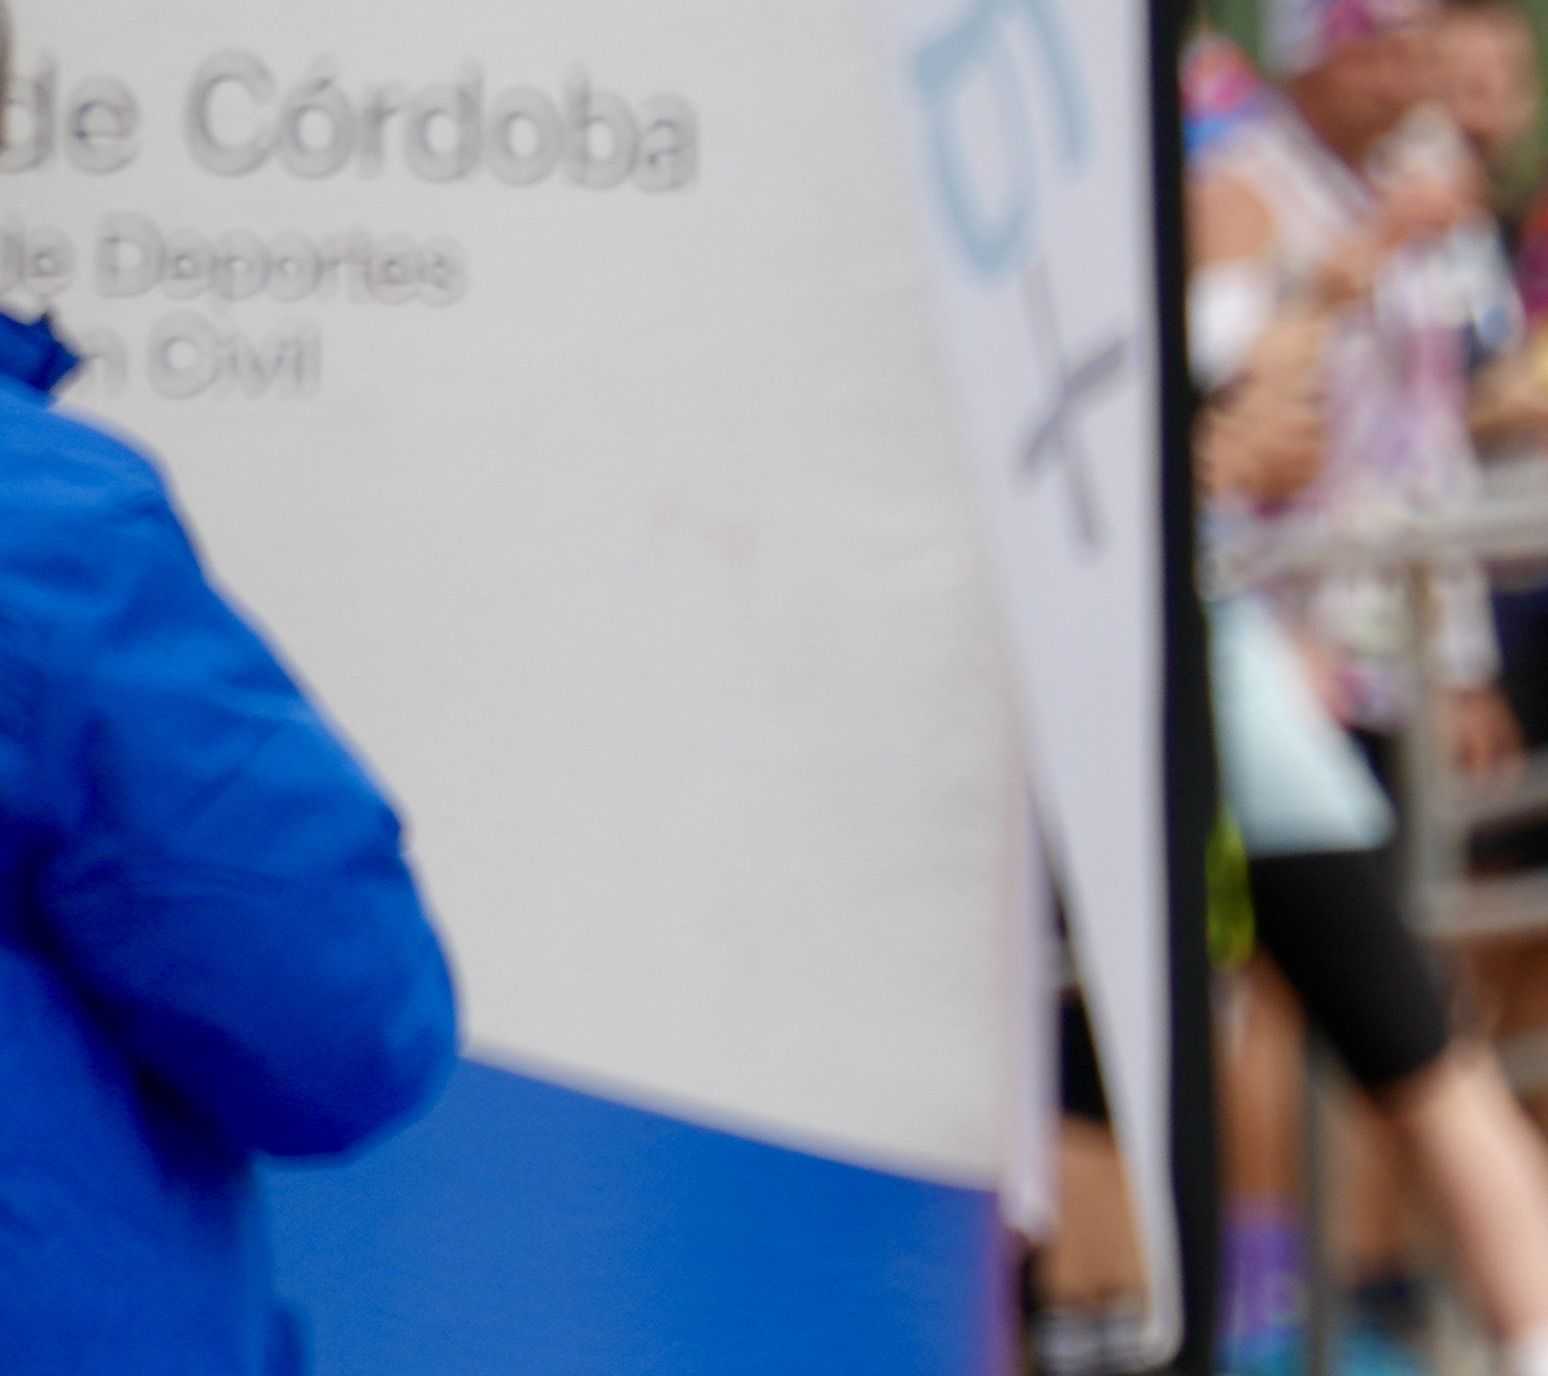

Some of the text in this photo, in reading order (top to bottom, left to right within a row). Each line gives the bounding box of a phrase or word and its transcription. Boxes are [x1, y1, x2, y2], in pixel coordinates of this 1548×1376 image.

[184, 46, 702, 194] Córdoba
[92, 208, 471, 312] Deportes
[146, 310, 323, 401] Civil
